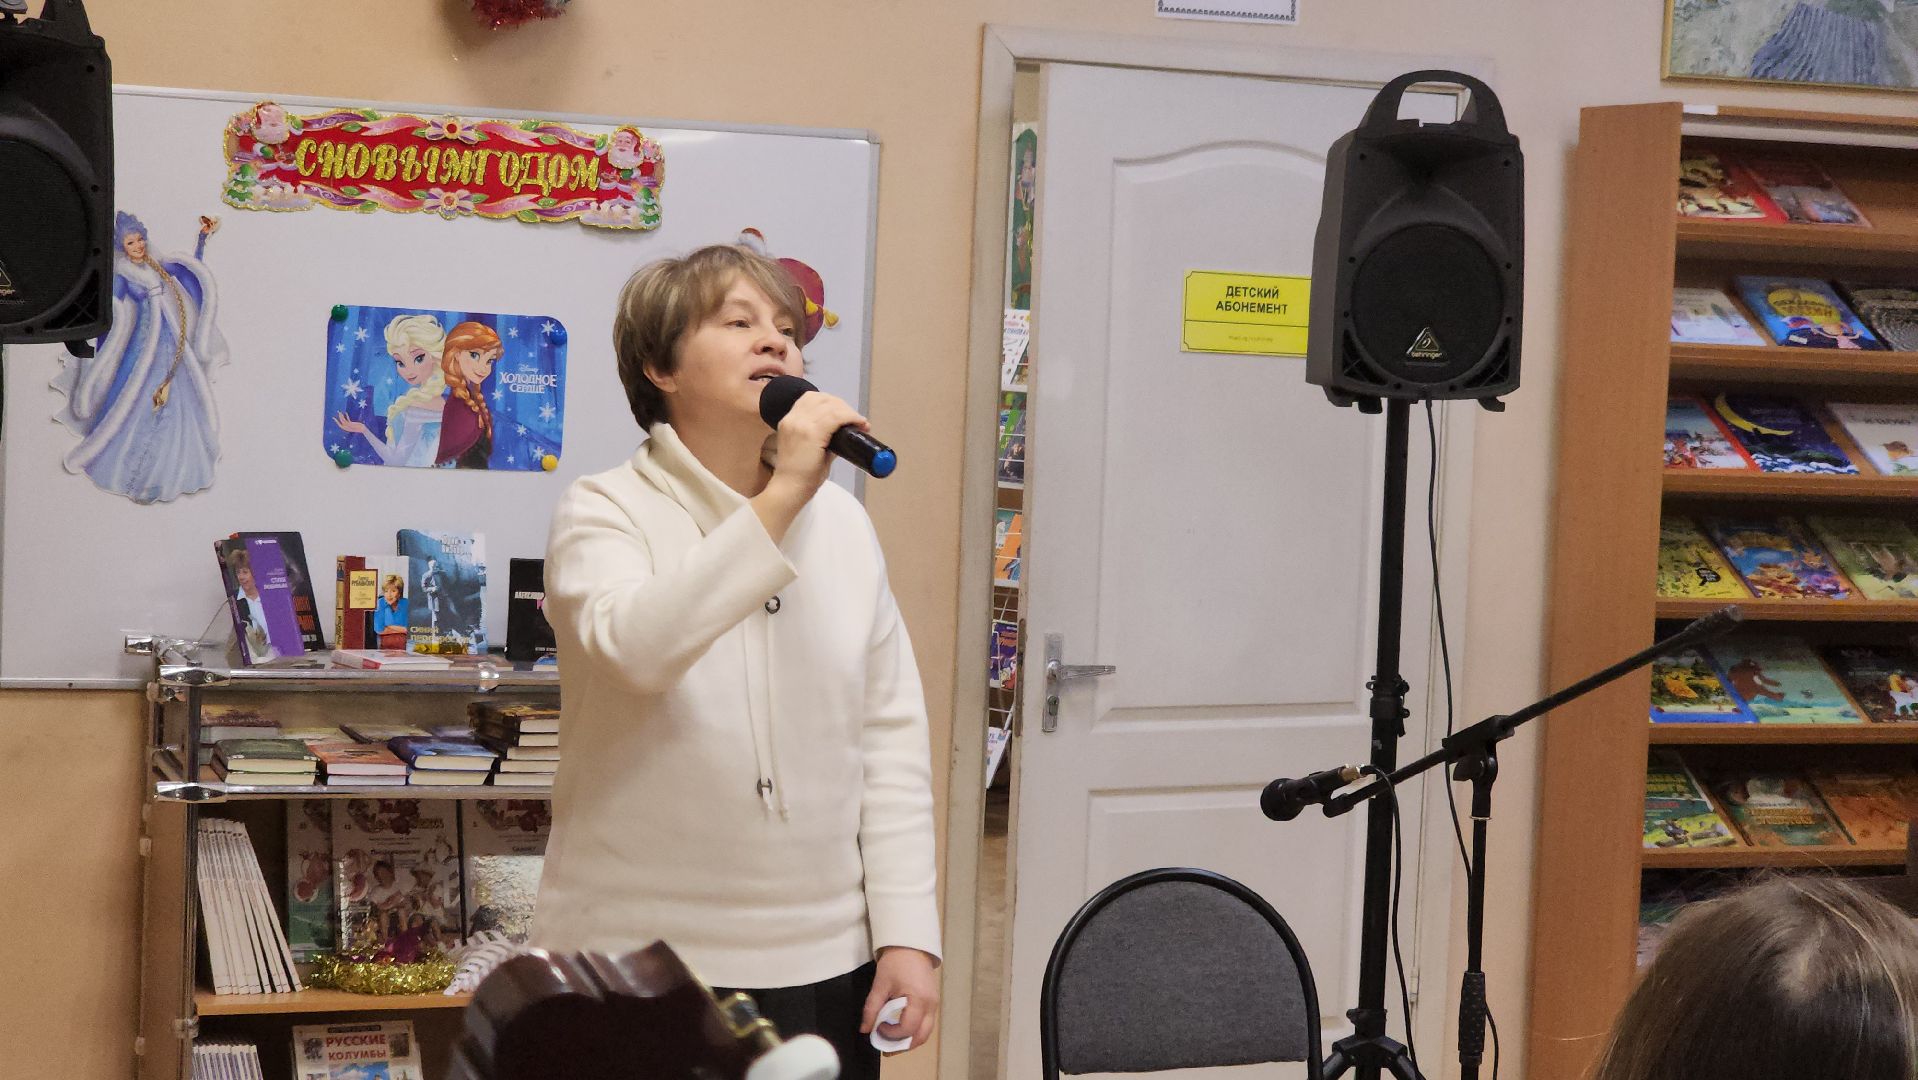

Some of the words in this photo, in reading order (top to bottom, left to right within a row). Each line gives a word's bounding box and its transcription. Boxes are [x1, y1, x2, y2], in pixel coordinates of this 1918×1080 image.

[1225, 285, 1279, 299] ДЕТСКИЙ
[1215, 301, 1288, 315] АБОНЕМЕНТ
[500, 372, 558, 387] ХОЛОДНОЕ
[326, 1033, 386, 1047] РУССКИЕ
[328, 1050, 387, 1061] КОЛУМБЫ
